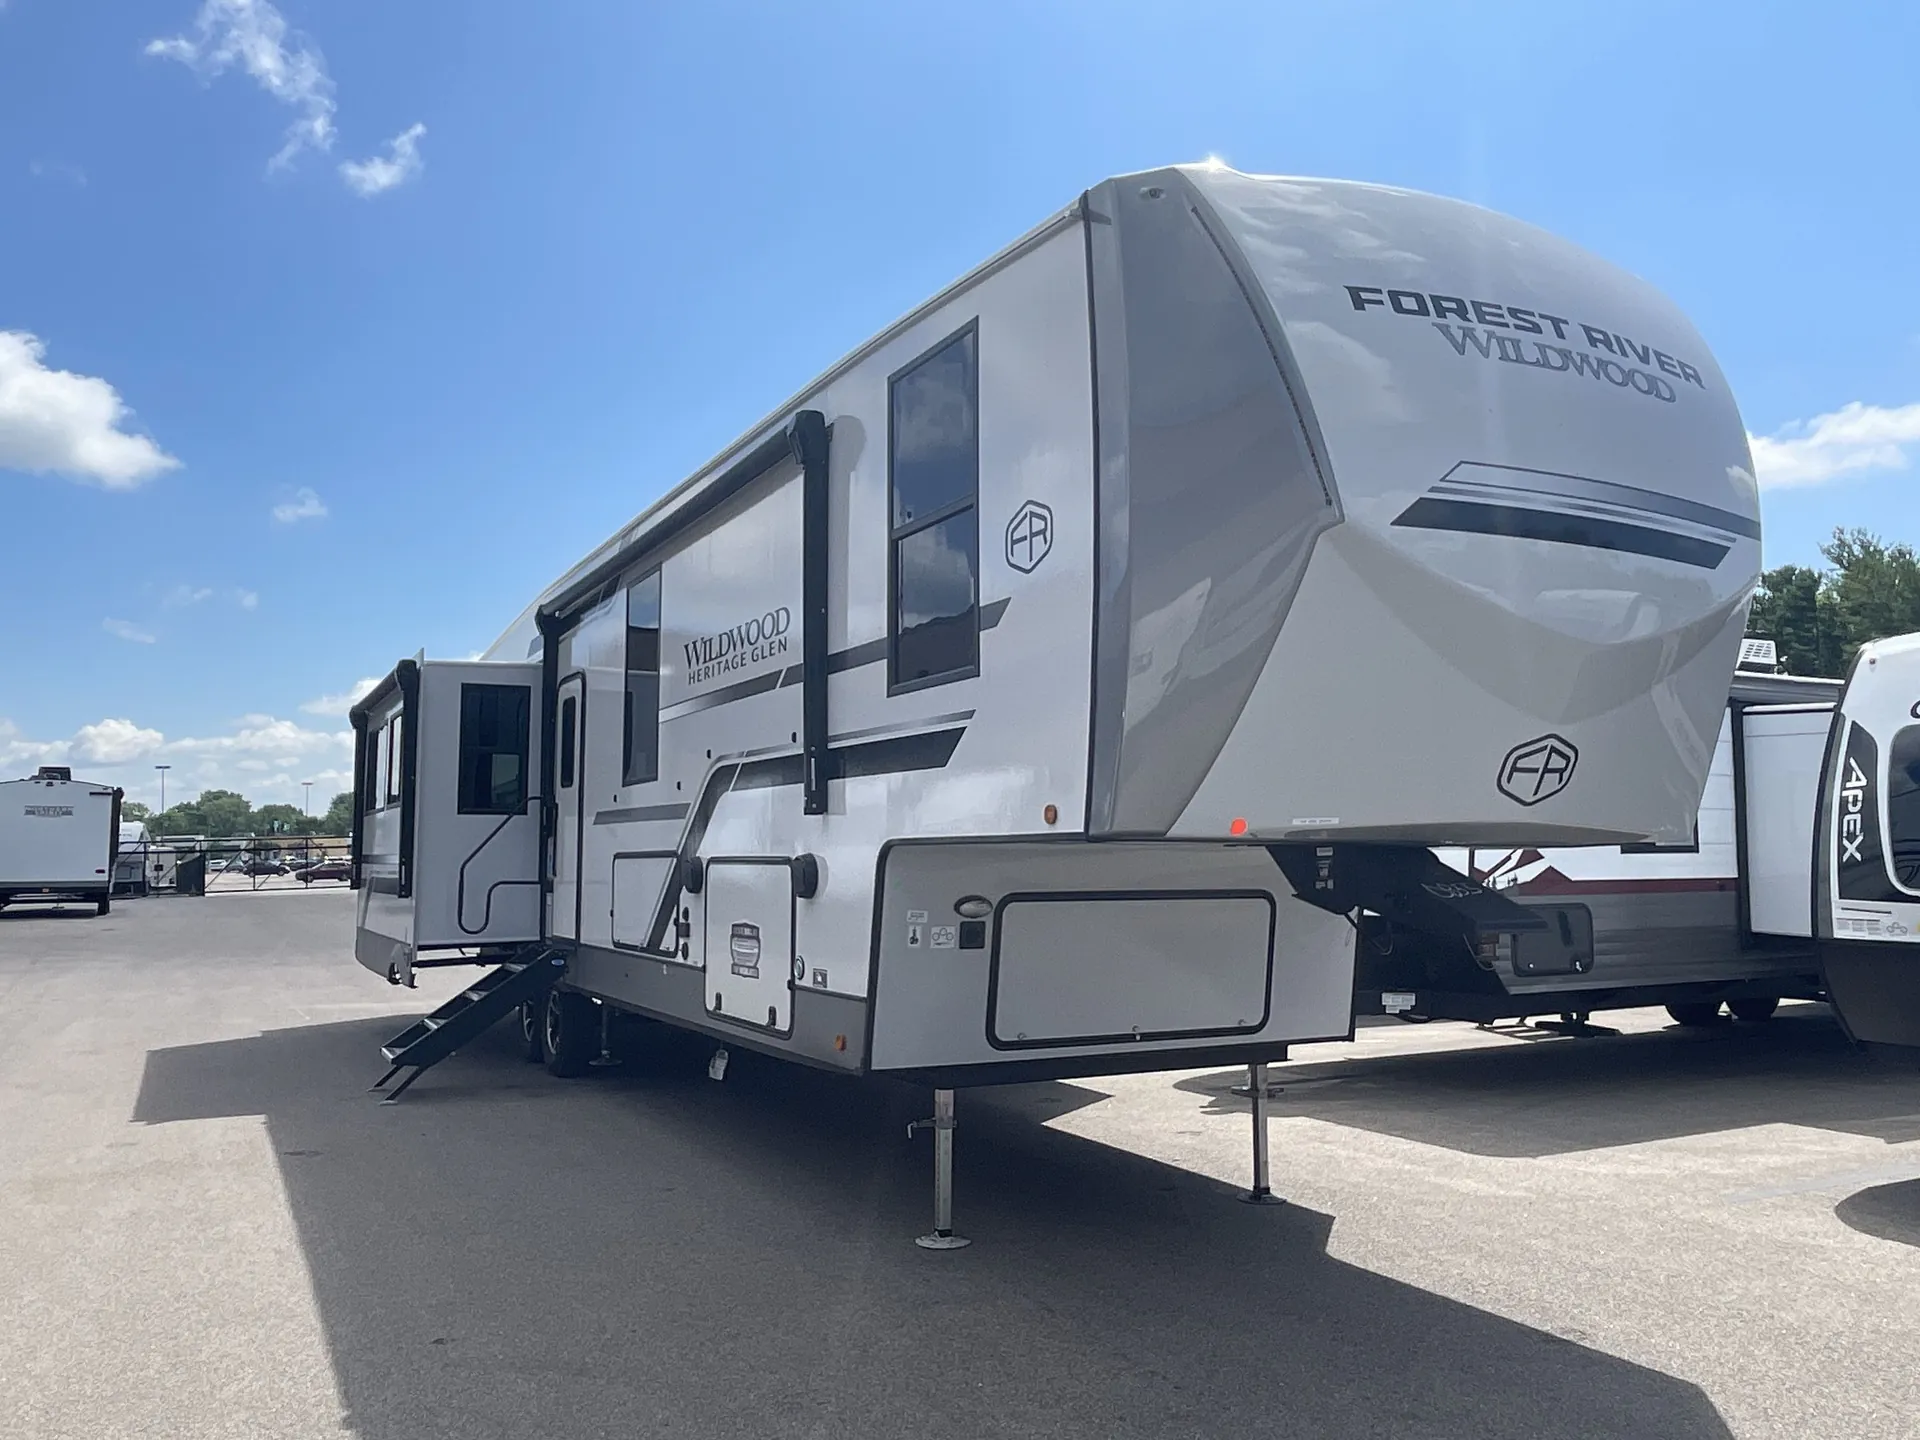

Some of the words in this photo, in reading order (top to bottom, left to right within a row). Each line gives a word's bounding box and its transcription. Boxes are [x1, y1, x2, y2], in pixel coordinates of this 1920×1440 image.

[1343, 285, 1570, 340] FOREST
[1577, 322, 1706, 390] RIVER
[1431, 321, 1677, 403] WILDWOOD
[683, 606, 791, 669] WILDWOOD
[687, 651, 747, 686] HERITAGE
[750, 635, 788, 663] GLEN
[1841, 756, 1868, 862] APEX
